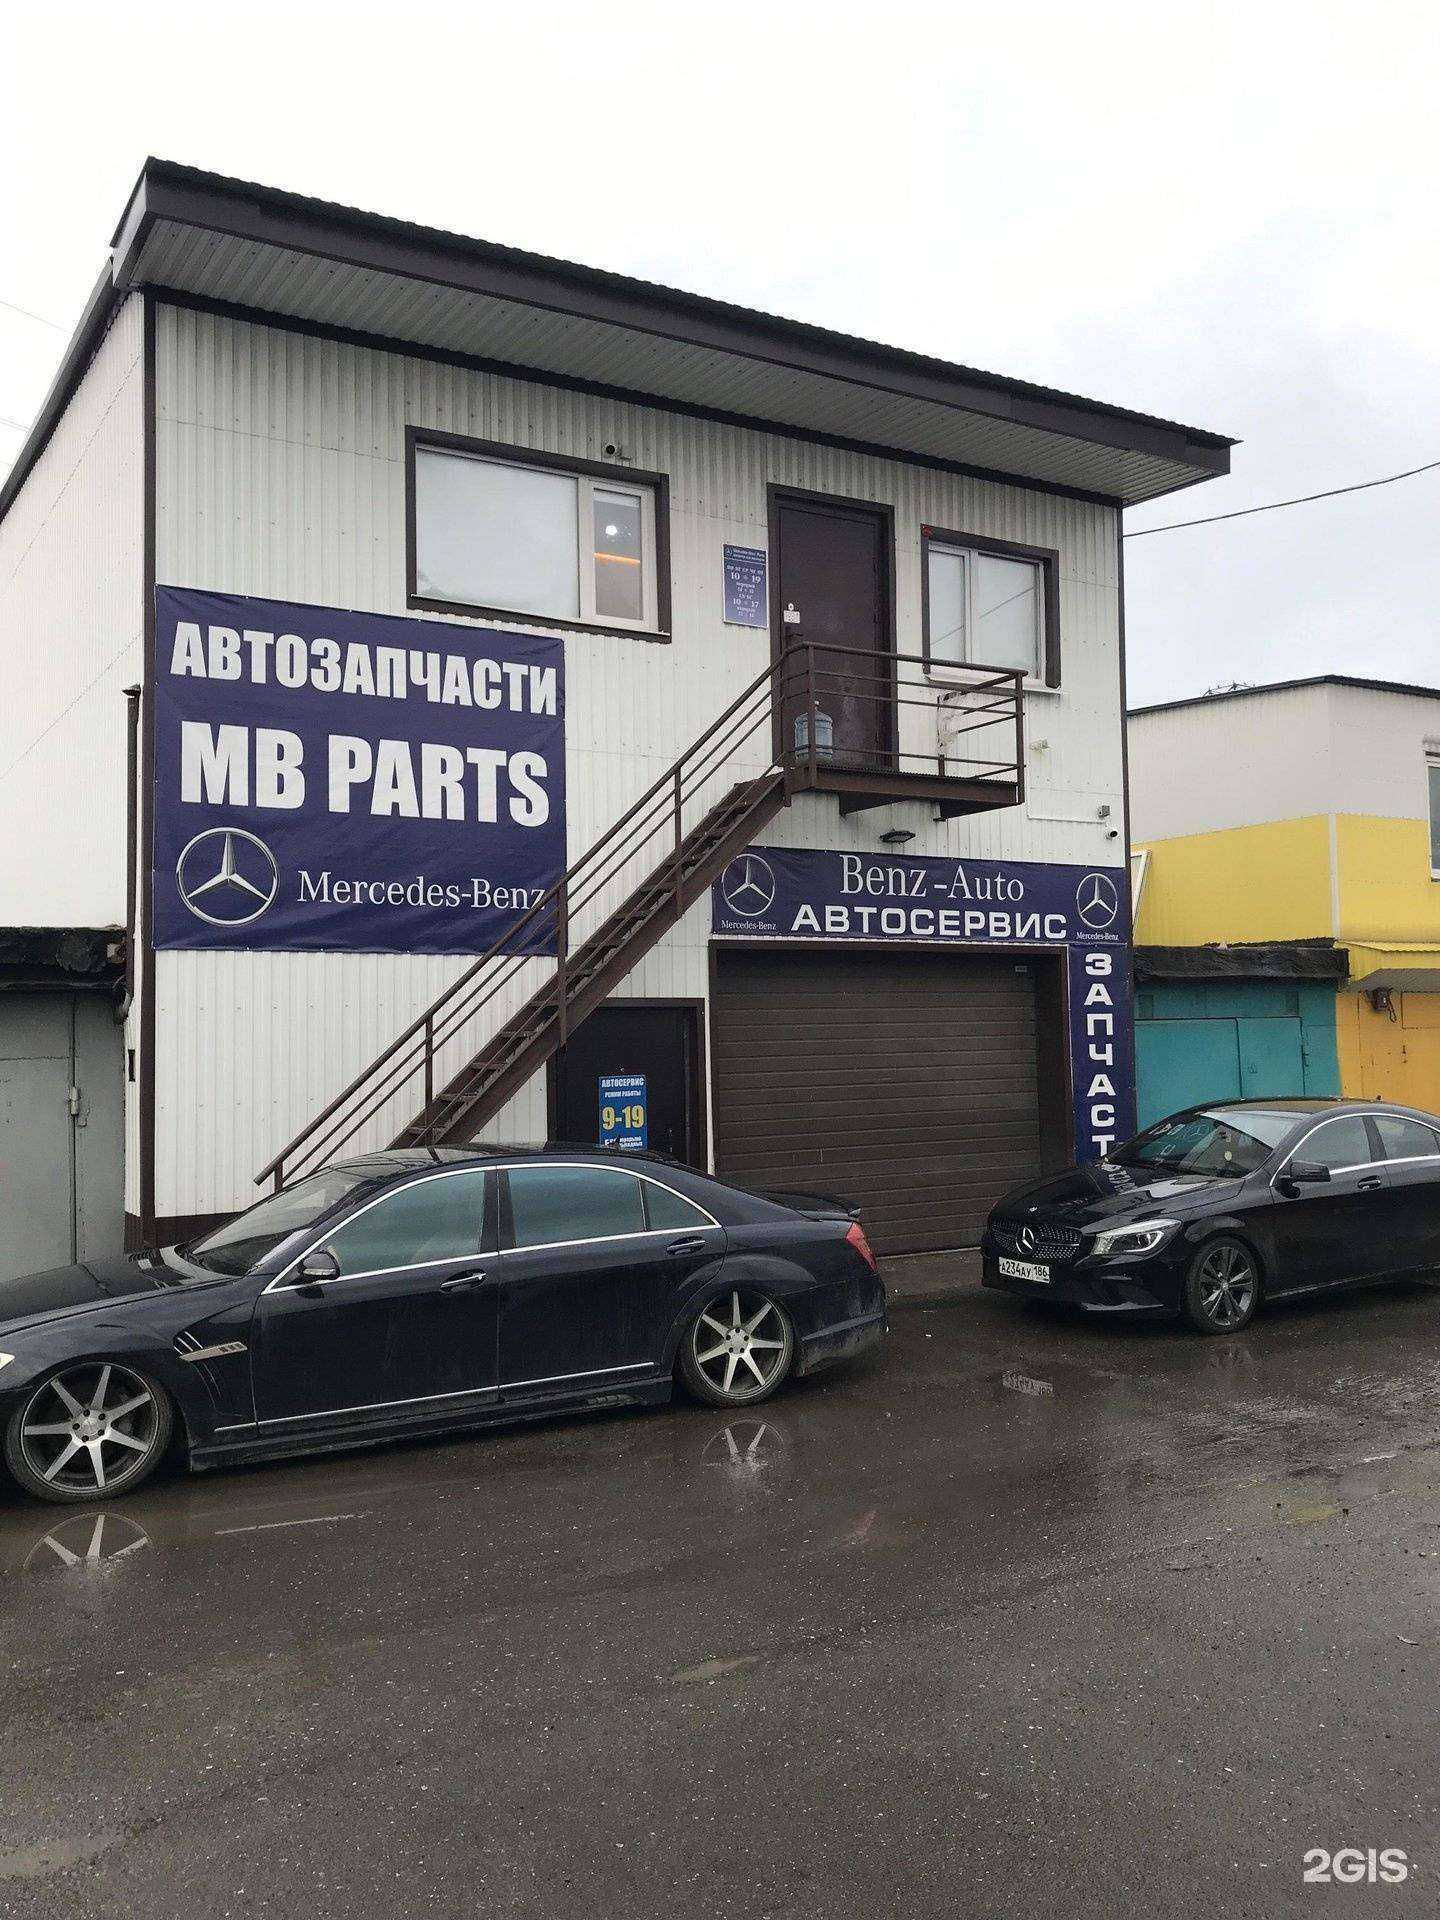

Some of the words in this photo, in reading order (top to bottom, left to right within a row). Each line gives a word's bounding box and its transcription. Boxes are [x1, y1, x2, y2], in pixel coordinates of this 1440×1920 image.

[170, 621, 557, 715] АВТОЗАПЧАСТИ
[181, 720, 305, 809] MB
[328, 734, 550, 827] PARTS
[297, 869, 546, 911] Mercedes-Benz
[721, 919, 777, 930] Mercedes-Benz
[791, 903, 1067, 939] АВТОСЕРВИС
[1083, 953, 1117, 1158] ЗАПЧАСТ
[601, 1078, 645, 1087] АВТОСЕРВИС
[602, 1105, 645, 1130] 9-19
